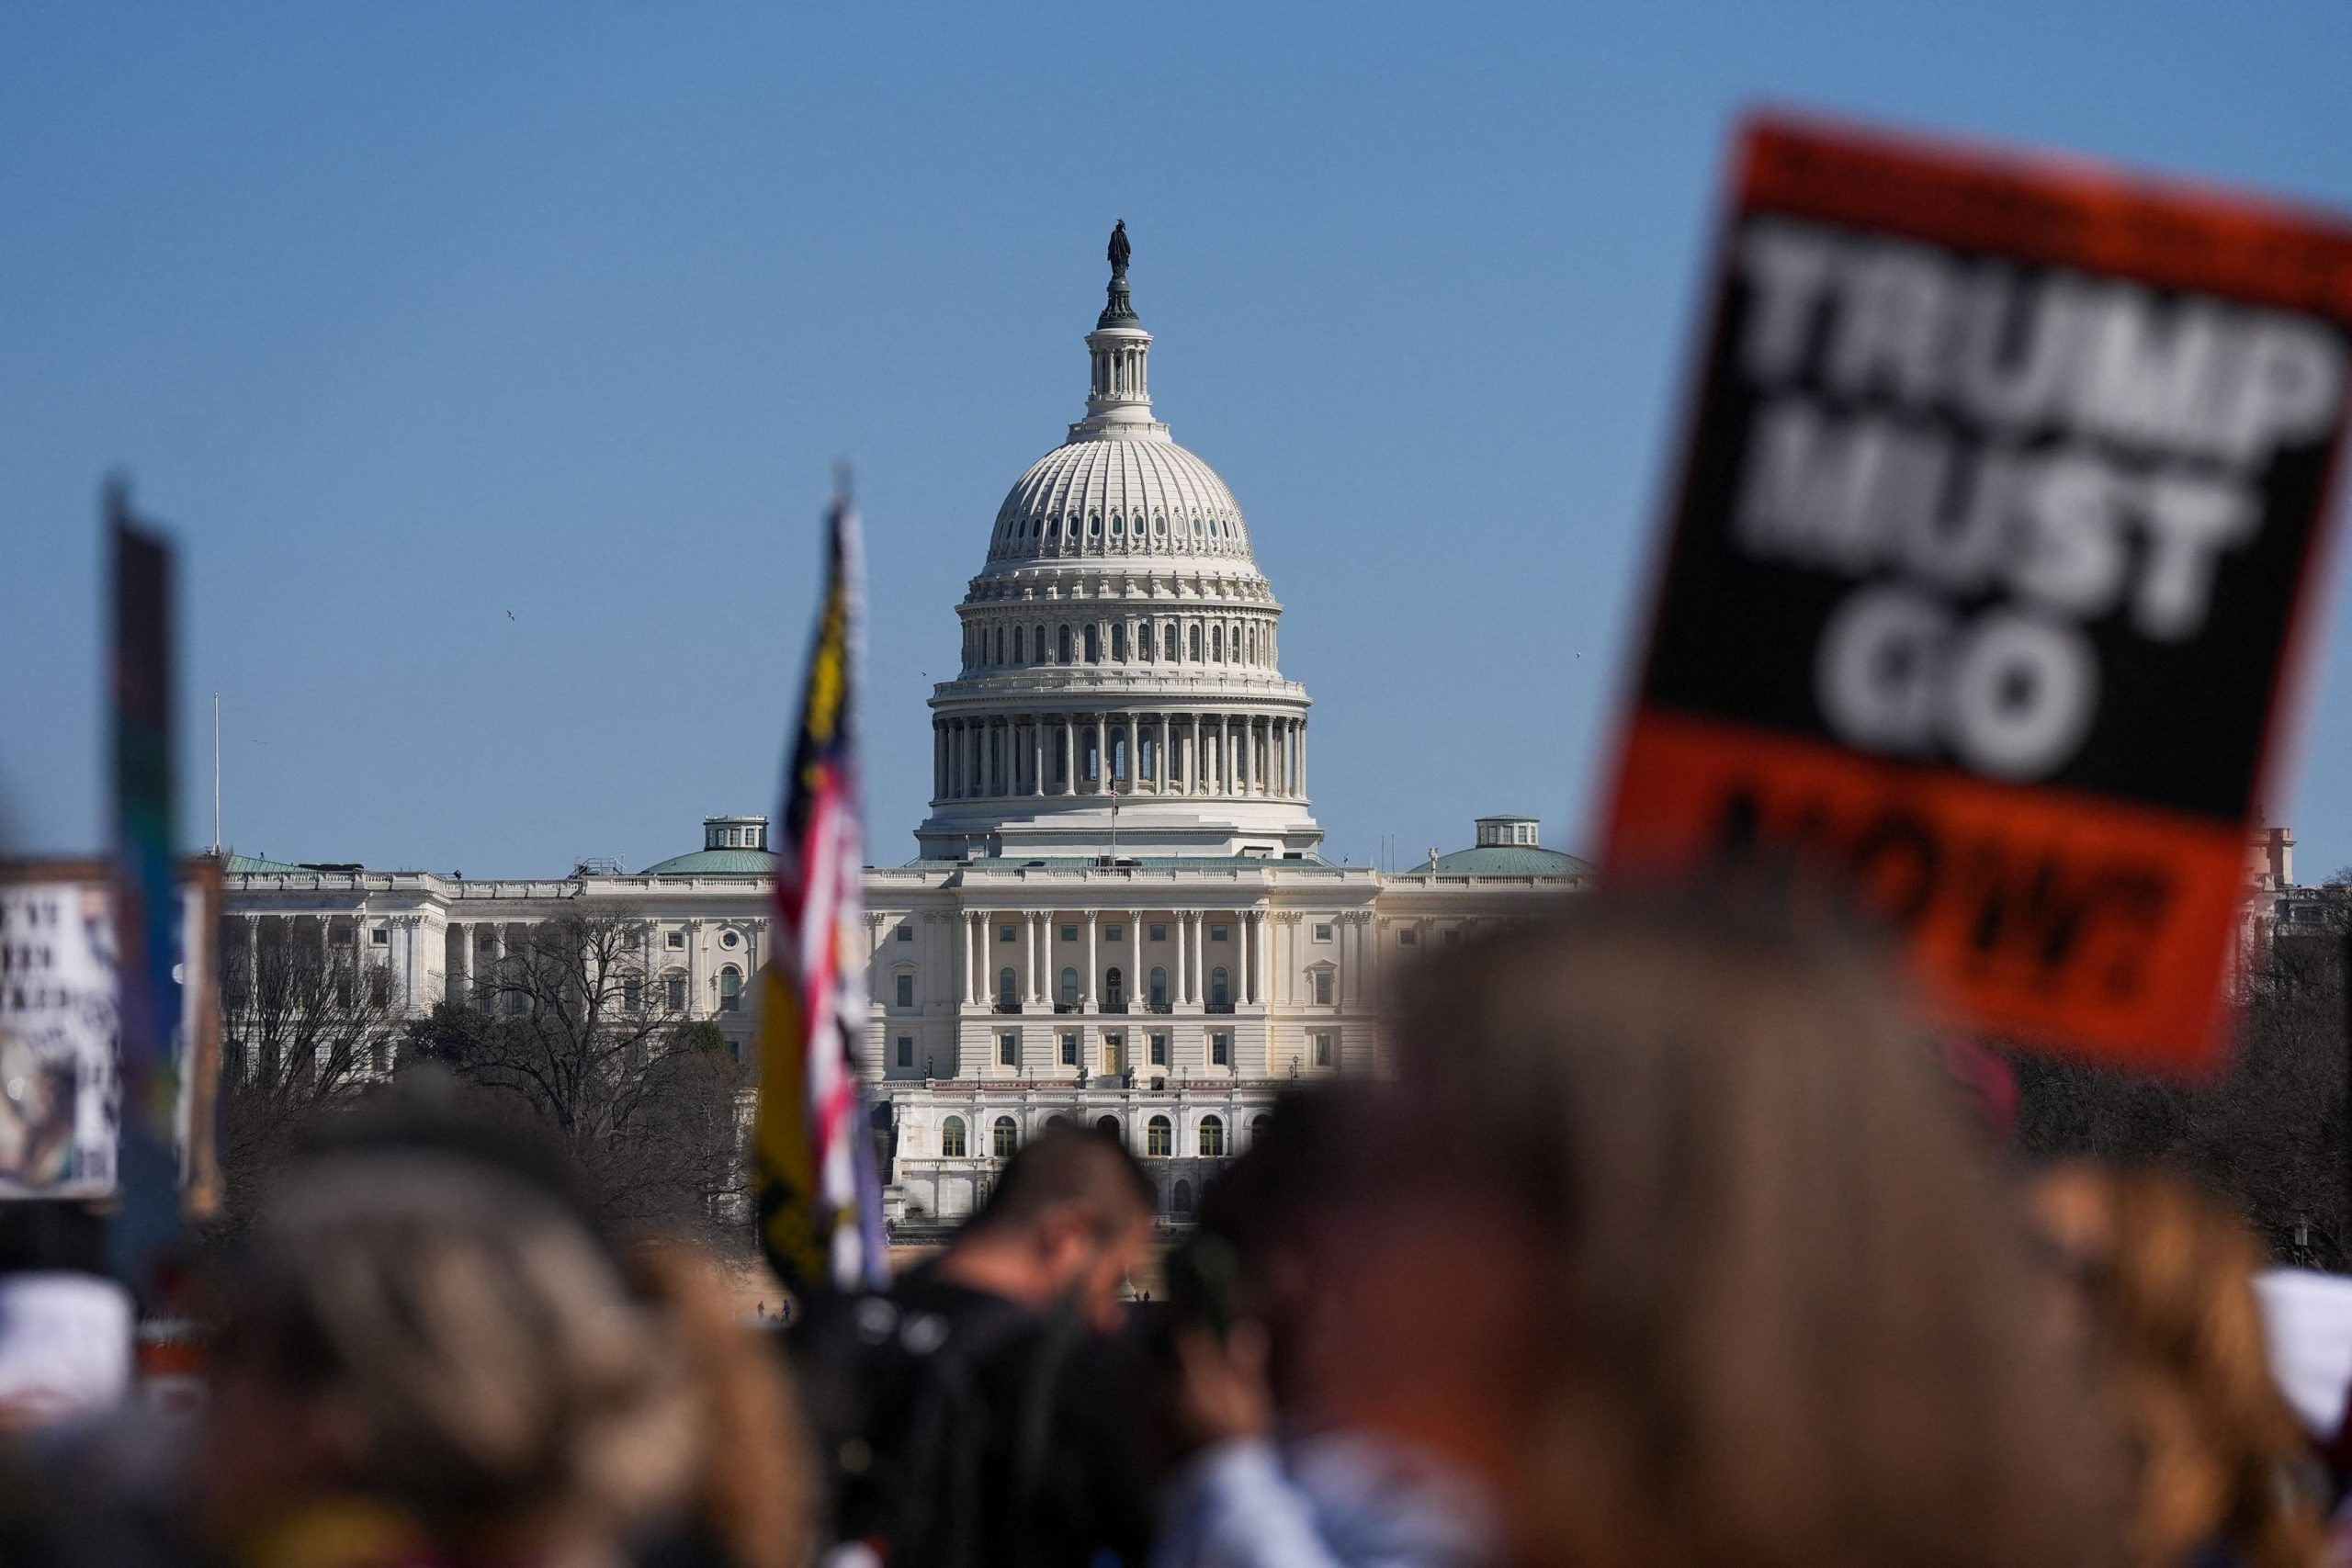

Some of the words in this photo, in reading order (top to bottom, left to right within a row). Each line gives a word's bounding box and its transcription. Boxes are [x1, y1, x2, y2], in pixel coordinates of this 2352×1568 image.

[1742, 223, 2346, 470] TRUMP
[1738, 402, 2258, 636] MUST
[1821, 586, 2095, 775] GO
